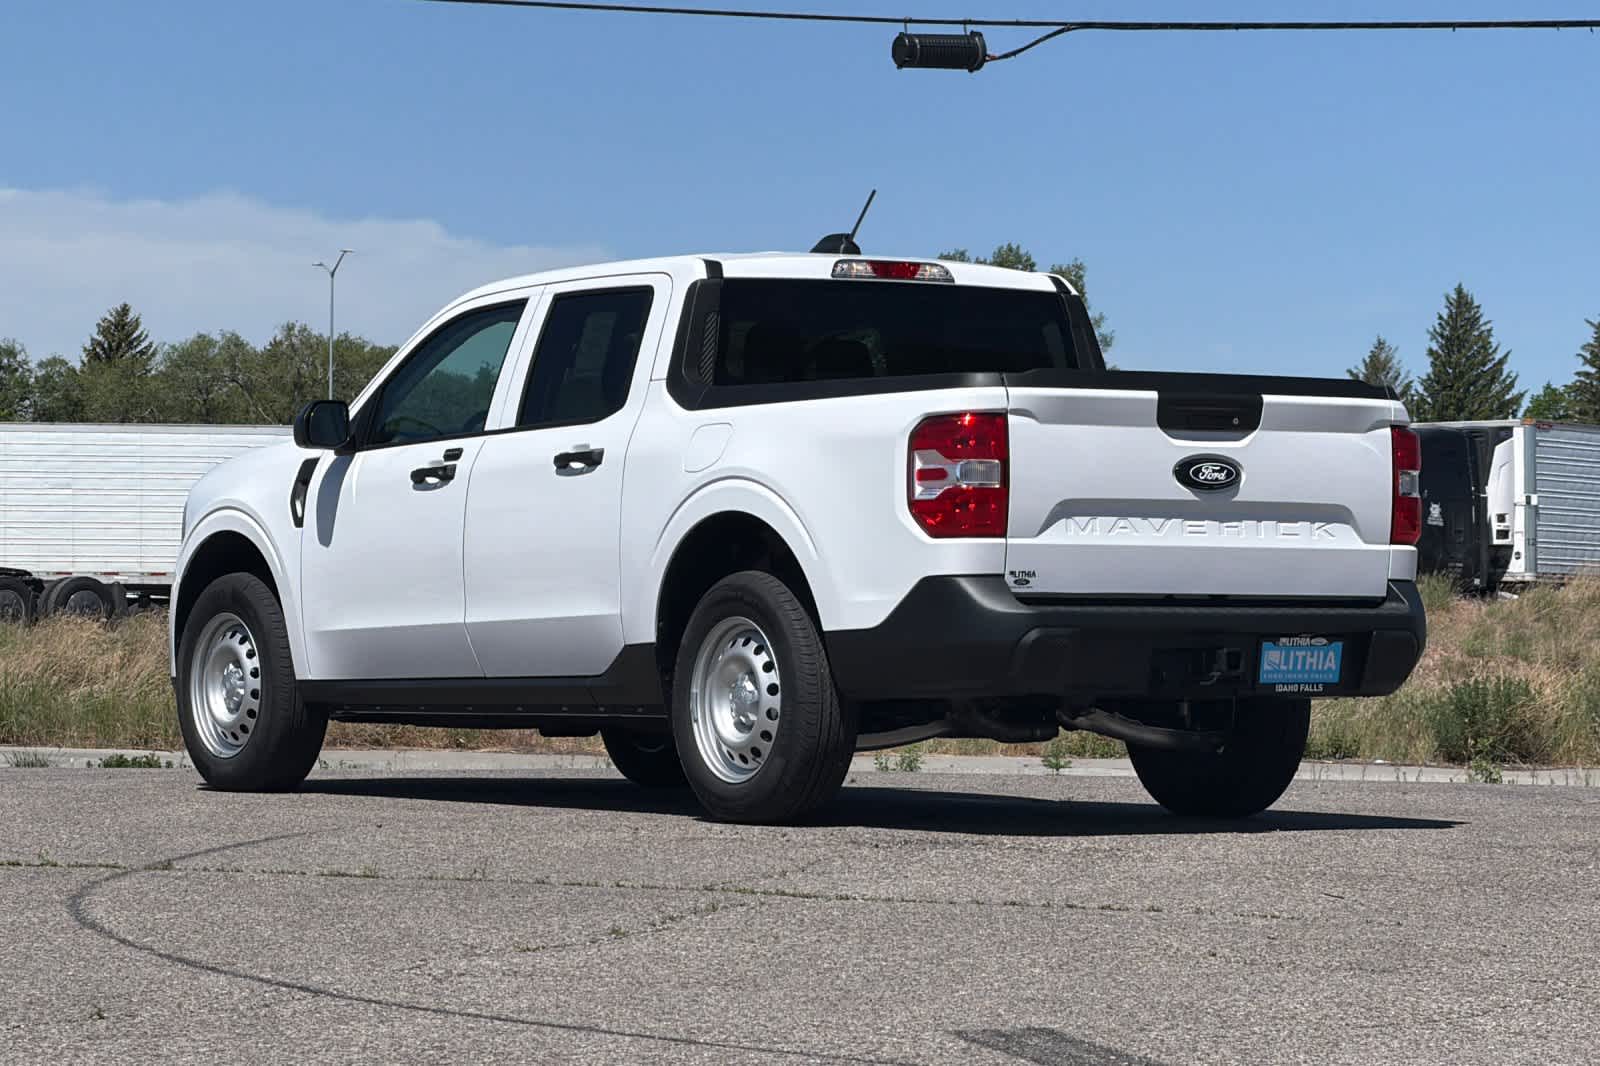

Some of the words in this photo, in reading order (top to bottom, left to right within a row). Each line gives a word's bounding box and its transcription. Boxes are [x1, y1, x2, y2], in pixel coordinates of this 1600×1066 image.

[1199, 465, 1227, 480] Ford
[1064, 516, 1337, 538] MAVERICK
[1280, 649, 1336, 671] LITHIA
[1275, 684, 1298, 692] IDAHO
[1299, 684, 1324, 692] FALLS
